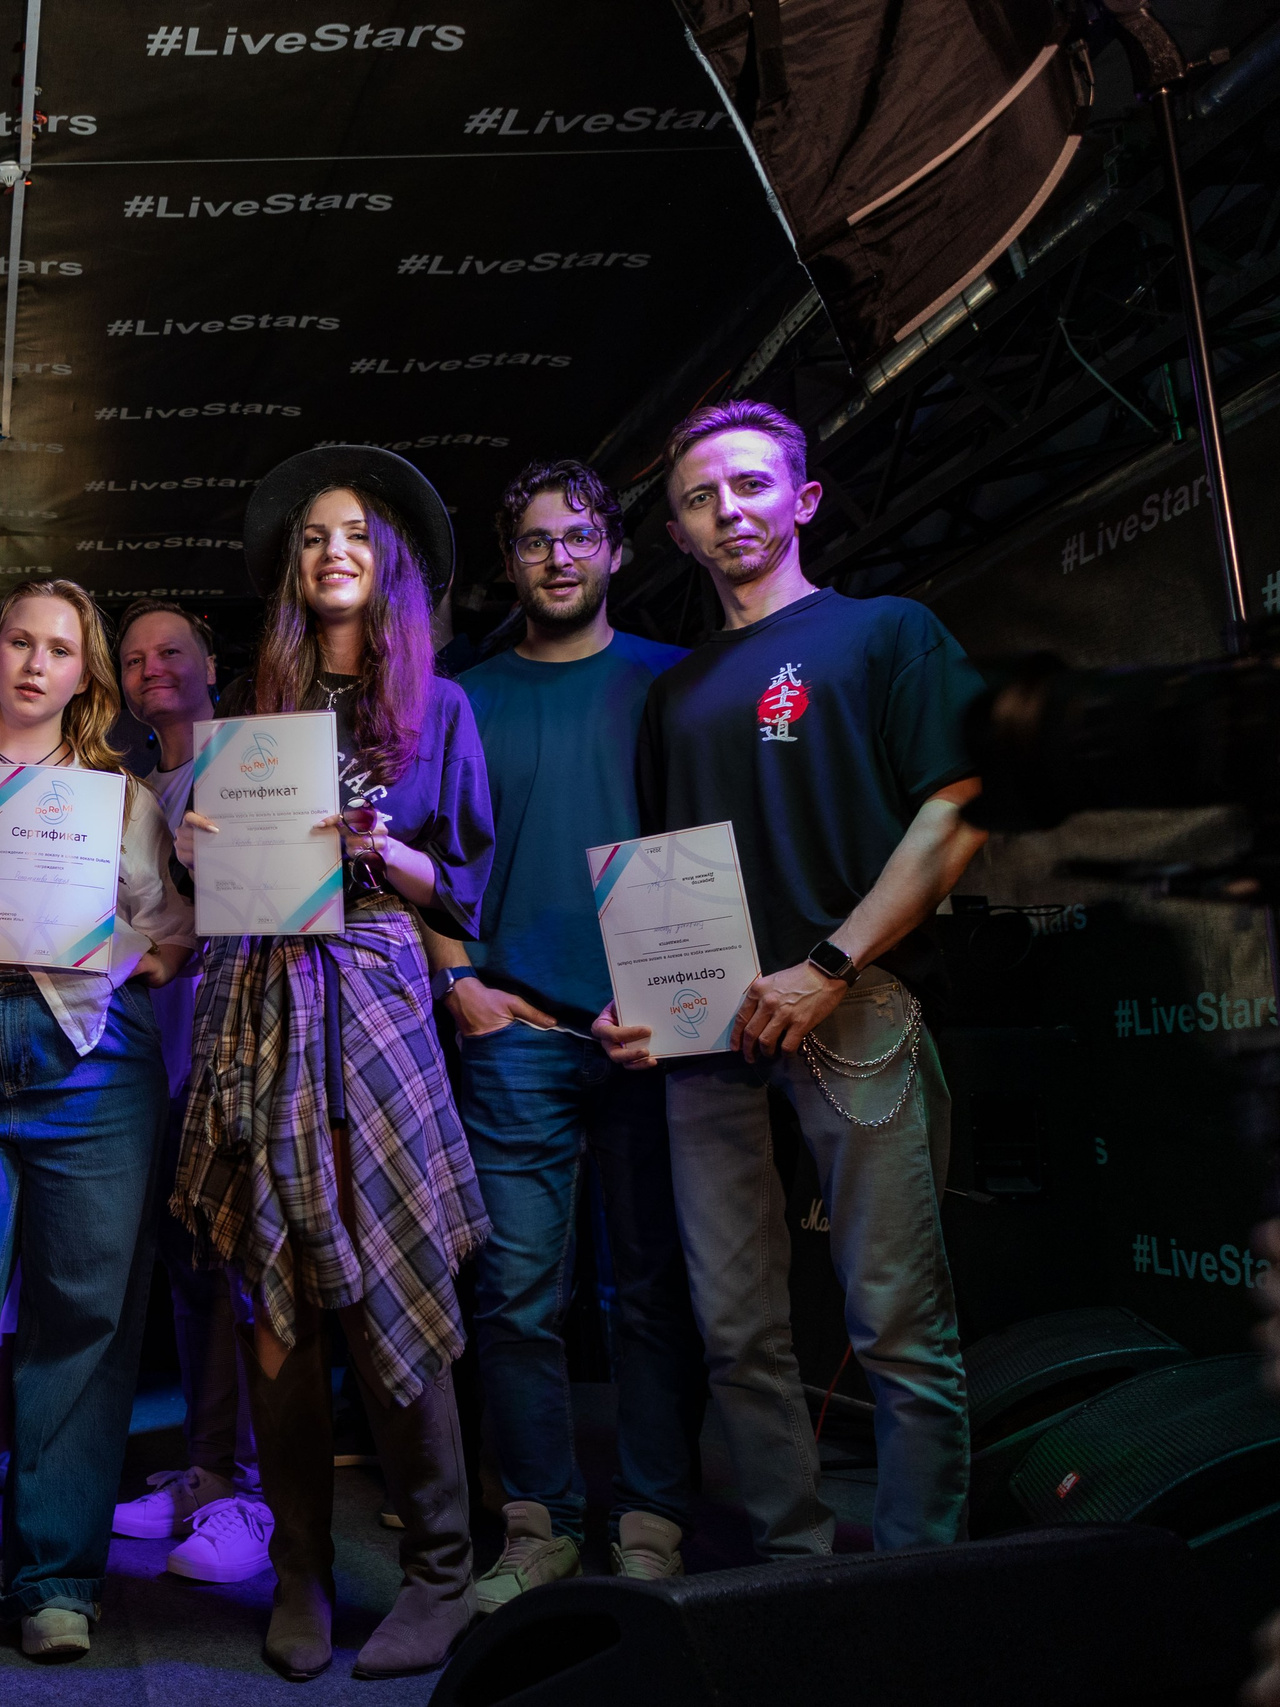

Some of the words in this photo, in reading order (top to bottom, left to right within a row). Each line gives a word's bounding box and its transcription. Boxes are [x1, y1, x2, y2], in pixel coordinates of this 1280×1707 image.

[146, 23, 467, 57] #LiveStars
[463, 107, 735, 135] #LiveStar
[123, 191, 394, 219] #LiveStars
[396, 251, 653, 275] #LiveStars
[106, 313, 341, 337] #LiveStars
[349, 352, 573, 375] #LiveStars
[94, 402, 302, 420] #LiveStars
[75, 536, 244, 552] #LiveStars
[90, 588, 225, 598] LiveStars
[220, 785, 299, 801] Сертификат
[11, 826, 88, 843] Сертификат
[647, 967, 726, 987] Сертификат
[1132, 1233, 1272, 1290] #LiveSta
